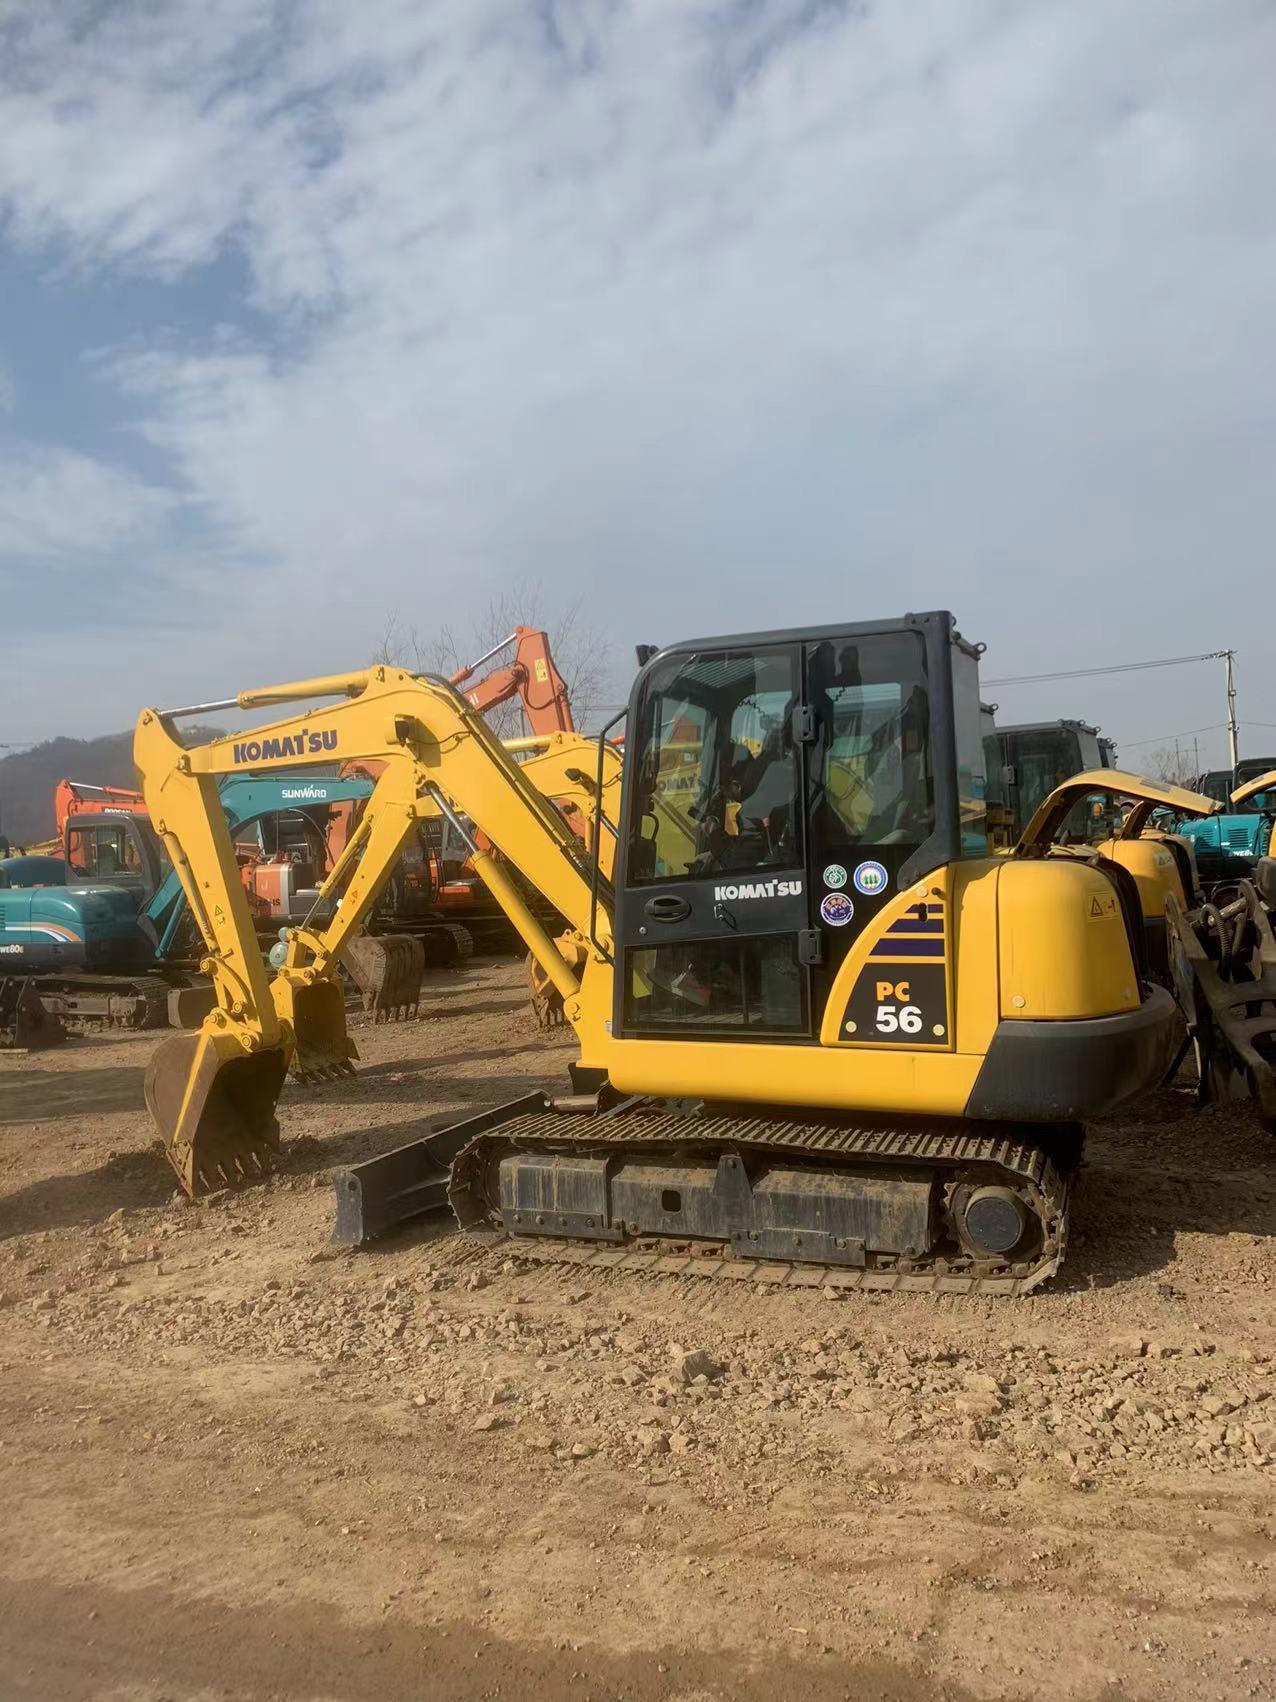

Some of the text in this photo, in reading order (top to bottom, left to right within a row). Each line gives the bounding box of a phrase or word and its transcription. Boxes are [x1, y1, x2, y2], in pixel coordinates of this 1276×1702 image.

[233, 729, 338, 764] KOMATSU
[281, 784, 327, 799] SUNWARD
[714, 879, 802, 901] KOMATSU
[876, 981, 910, 1002] PC
[875, 1005, 923, 1034] 56
